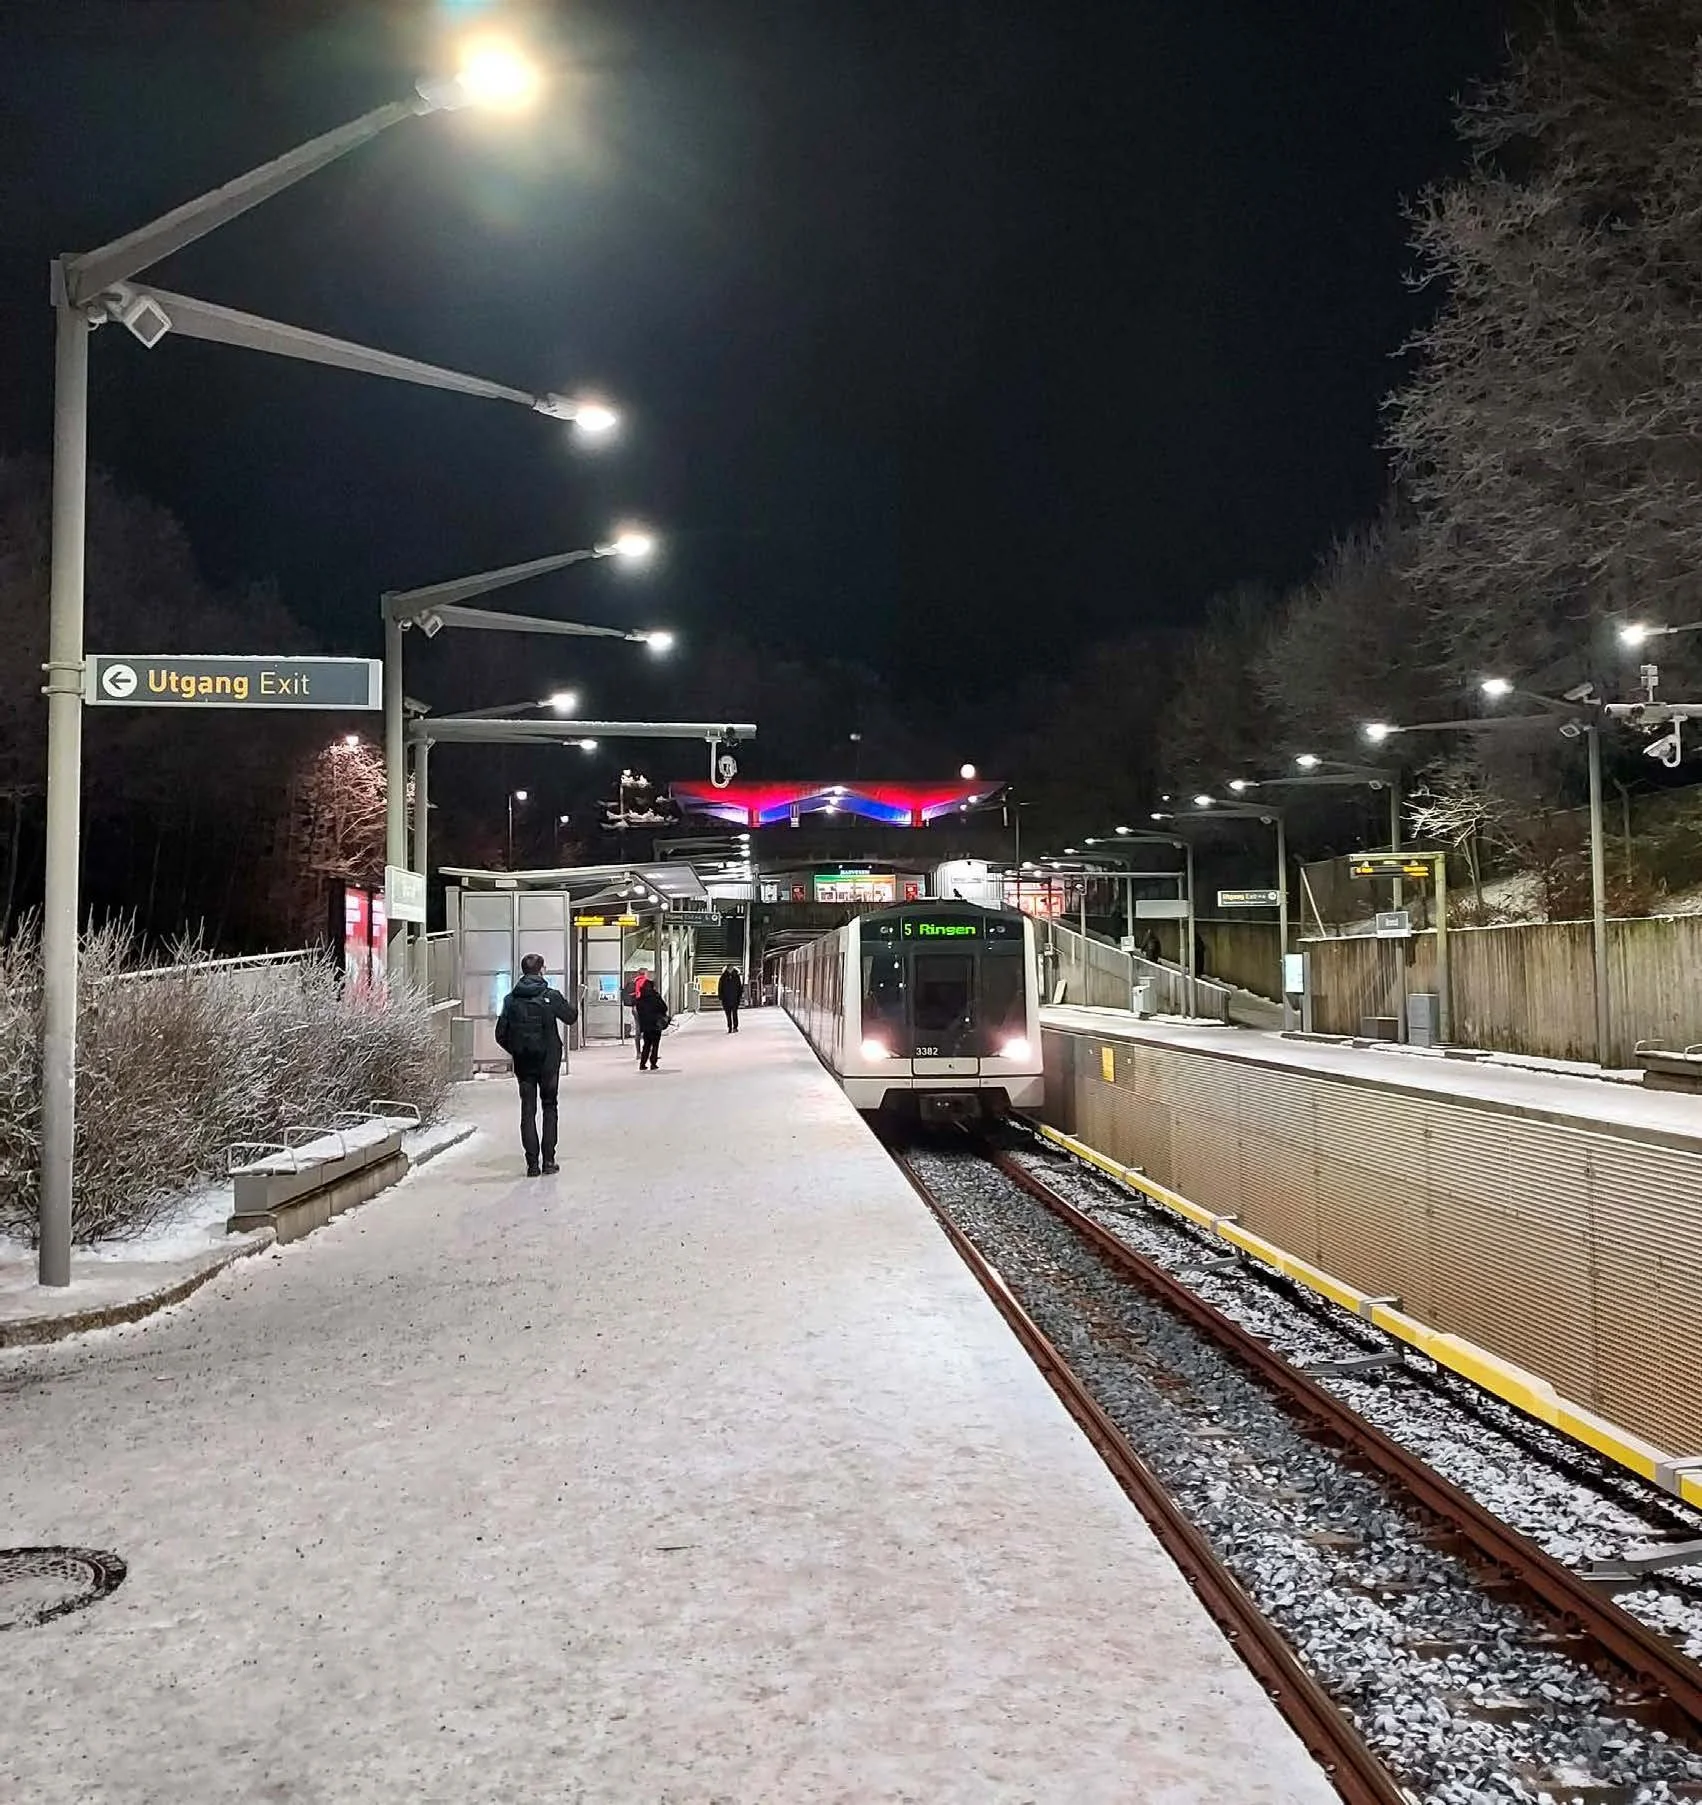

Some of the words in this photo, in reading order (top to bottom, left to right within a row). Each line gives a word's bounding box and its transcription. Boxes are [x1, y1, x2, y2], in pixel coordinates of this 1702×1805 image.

[148, 669, 249, 700] Utgang
[260, 671, 311, 696] Exit
[904, 923, 912, 936] 5
[919, 923, 976, 936] Ringen
[915, 1047, 939, 1056] 3382
